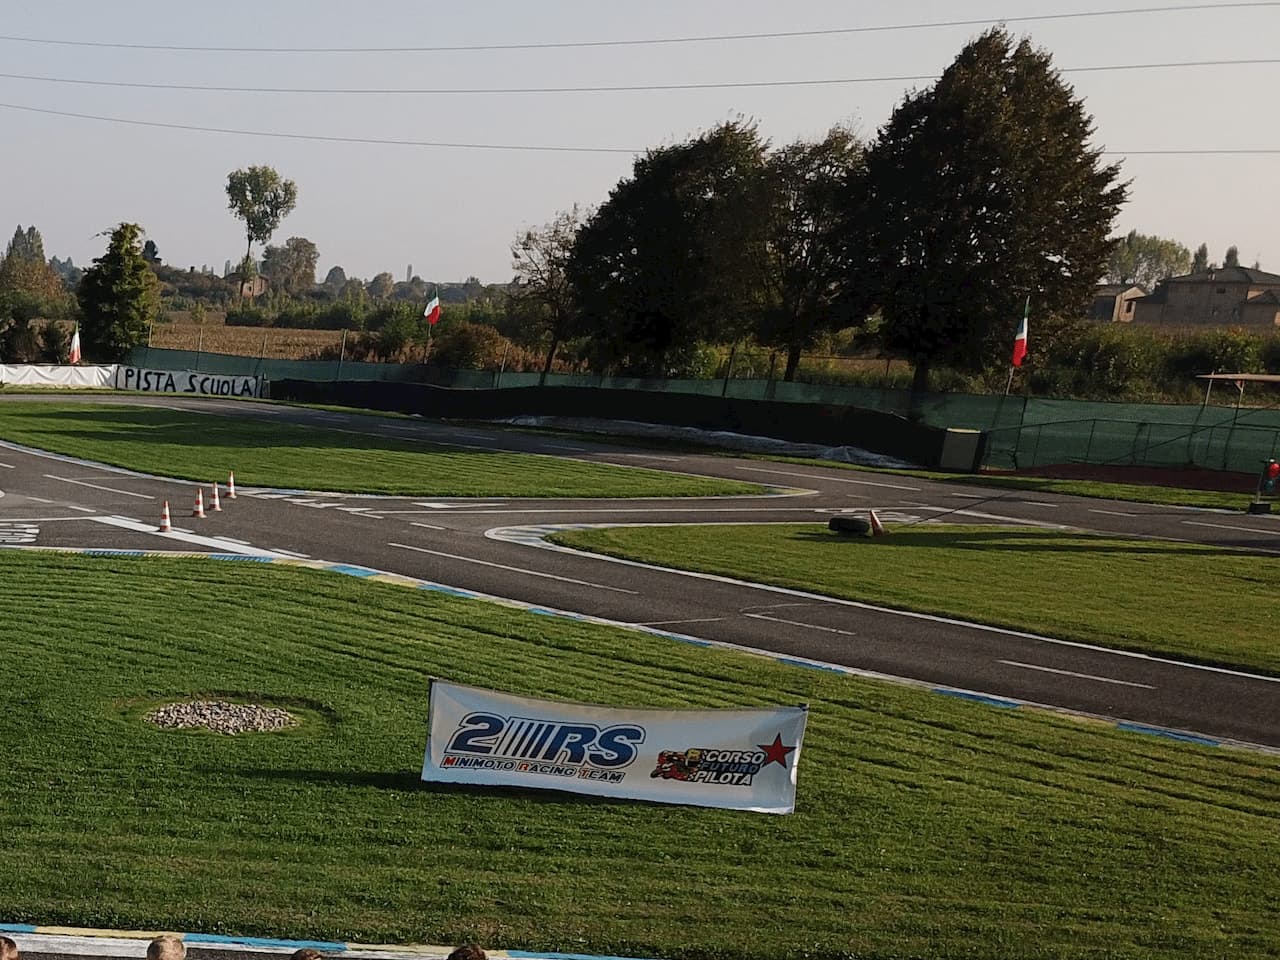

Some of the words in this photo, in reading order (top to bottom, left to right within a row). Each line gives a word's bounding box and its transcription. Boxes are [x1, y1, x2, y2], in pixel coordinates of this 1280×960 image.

[125, 369, 176, 392] PISTA
[184, 375, 253, 396] SCUOLA
[705, 750, 766, 764] CORSO
[442, 757, 514, 770] MINIMOTO
[519, 762, 575, 775] RACING
[580, 769, 623, 783] TEAM
[700, 762, 760, 774] FUTURO
[694, 771, 752, 785] PILOTA
